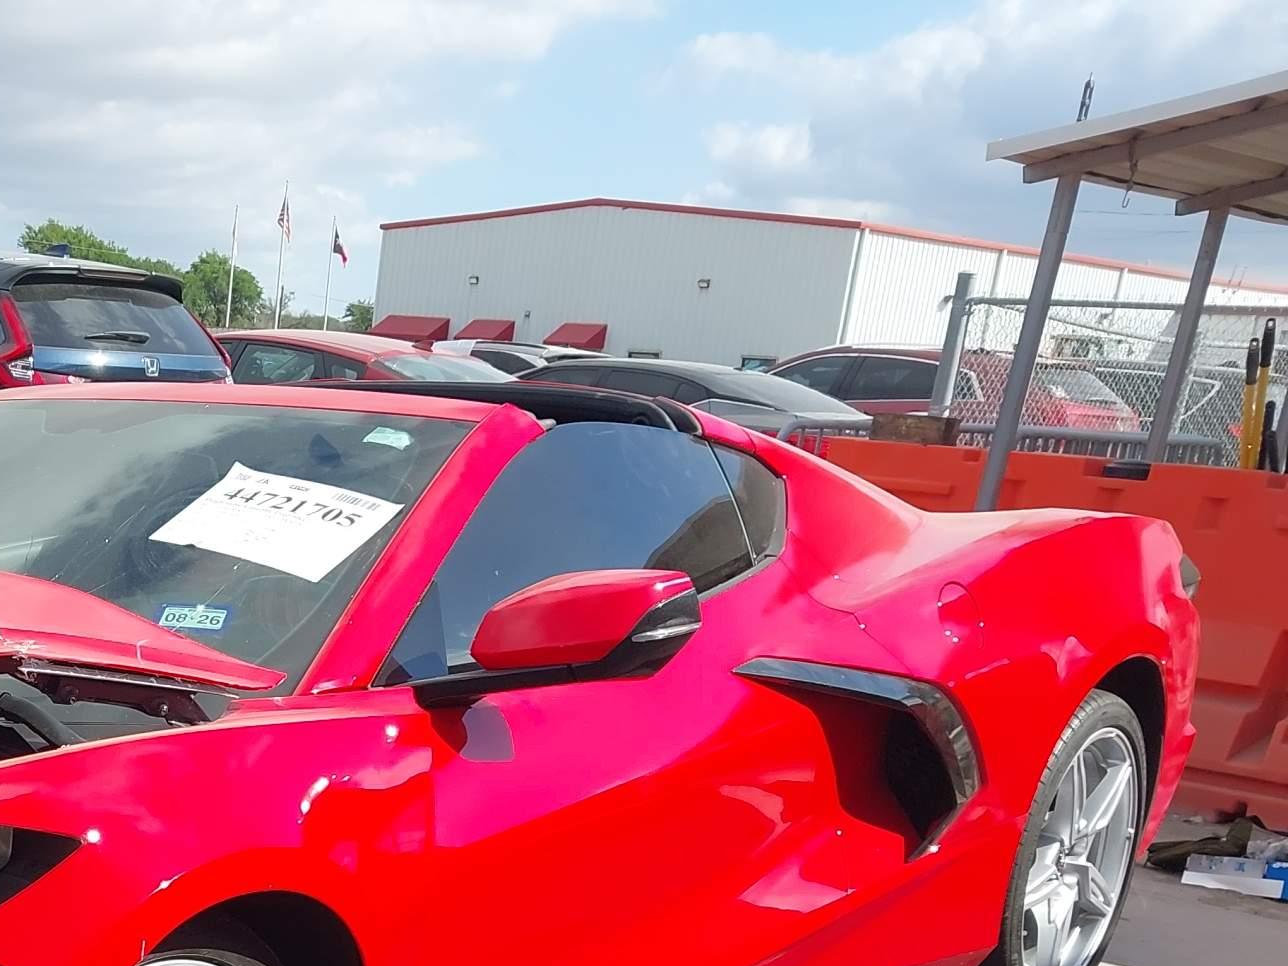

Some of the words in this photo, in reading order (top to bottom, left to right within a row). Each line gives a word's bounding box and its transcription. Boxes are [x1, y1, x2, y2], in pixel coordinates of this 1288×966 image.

[223, 486, 364, 529] 44721705
[164, 612, 189, 624] 08
[196, 614, 223, 626] 26
